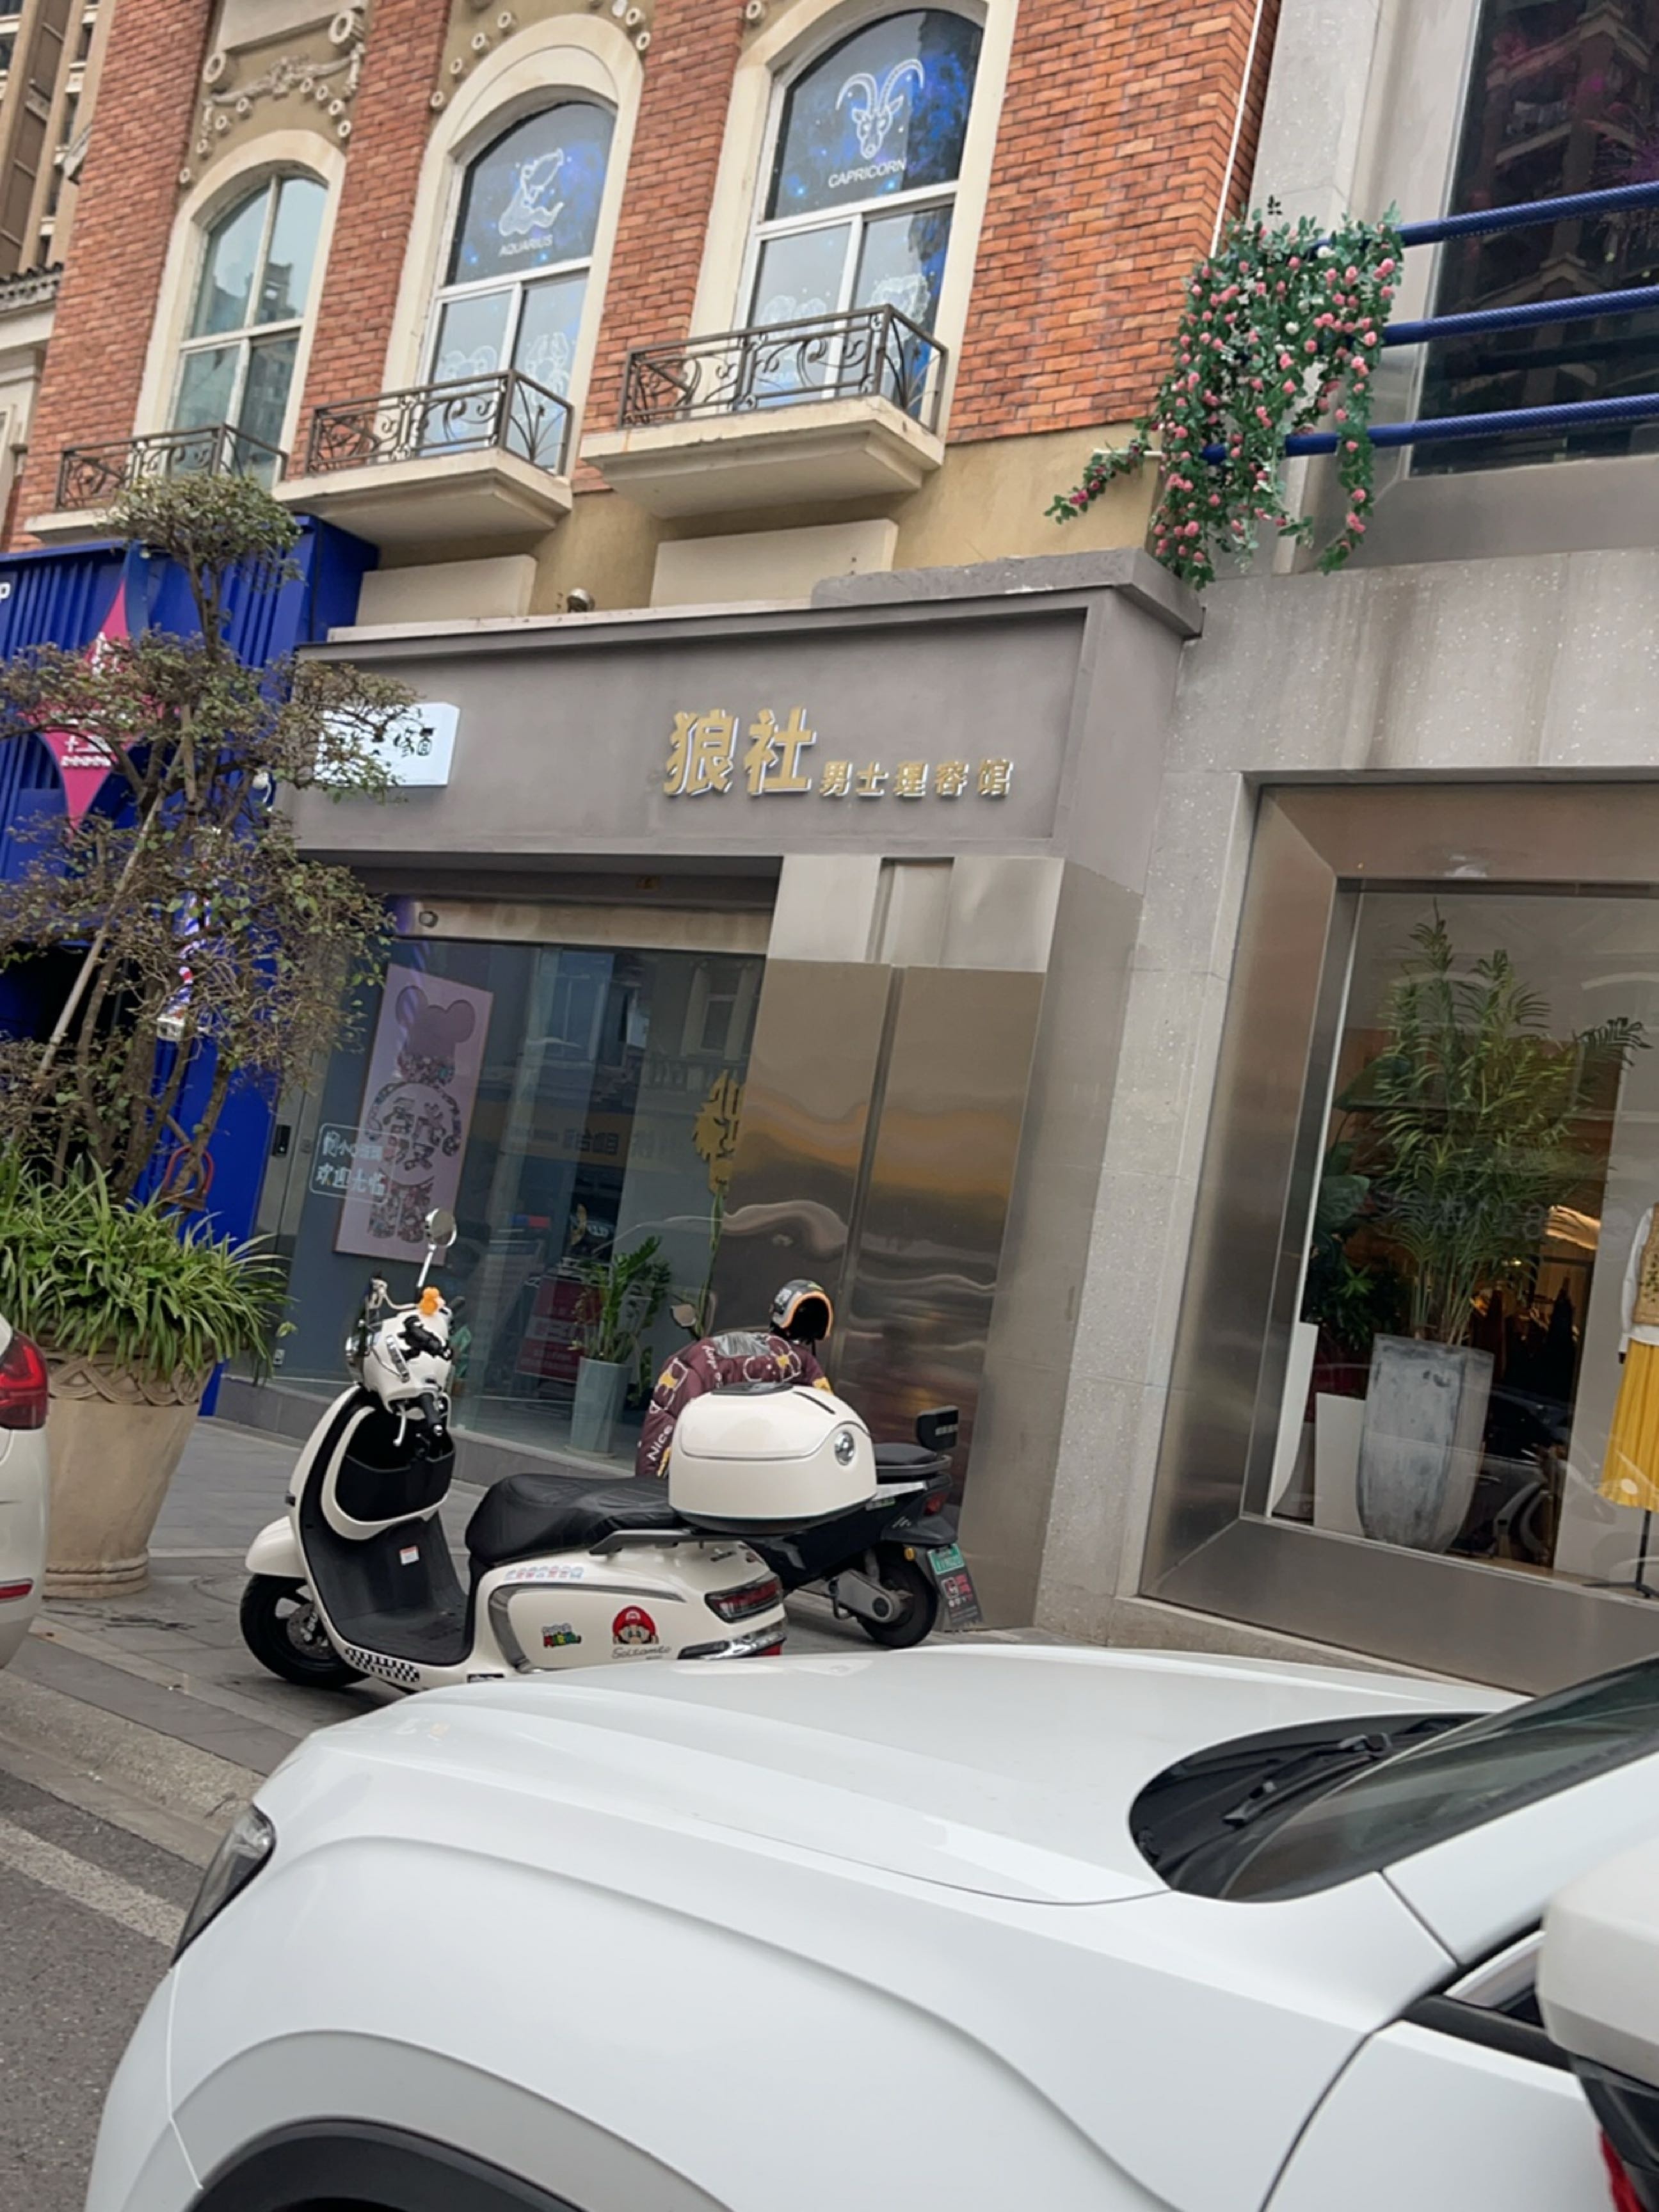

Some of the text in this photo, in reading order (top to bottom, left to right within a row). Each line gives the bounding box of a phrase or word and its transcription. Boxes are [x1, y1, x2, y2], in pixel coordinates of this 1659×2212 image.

[828, 158, 906, 188] CAPRICORN
[499, 234, 553, 256] AQUARIUS
[664, 707, 1014, 797] 狼社 男士理容馆
